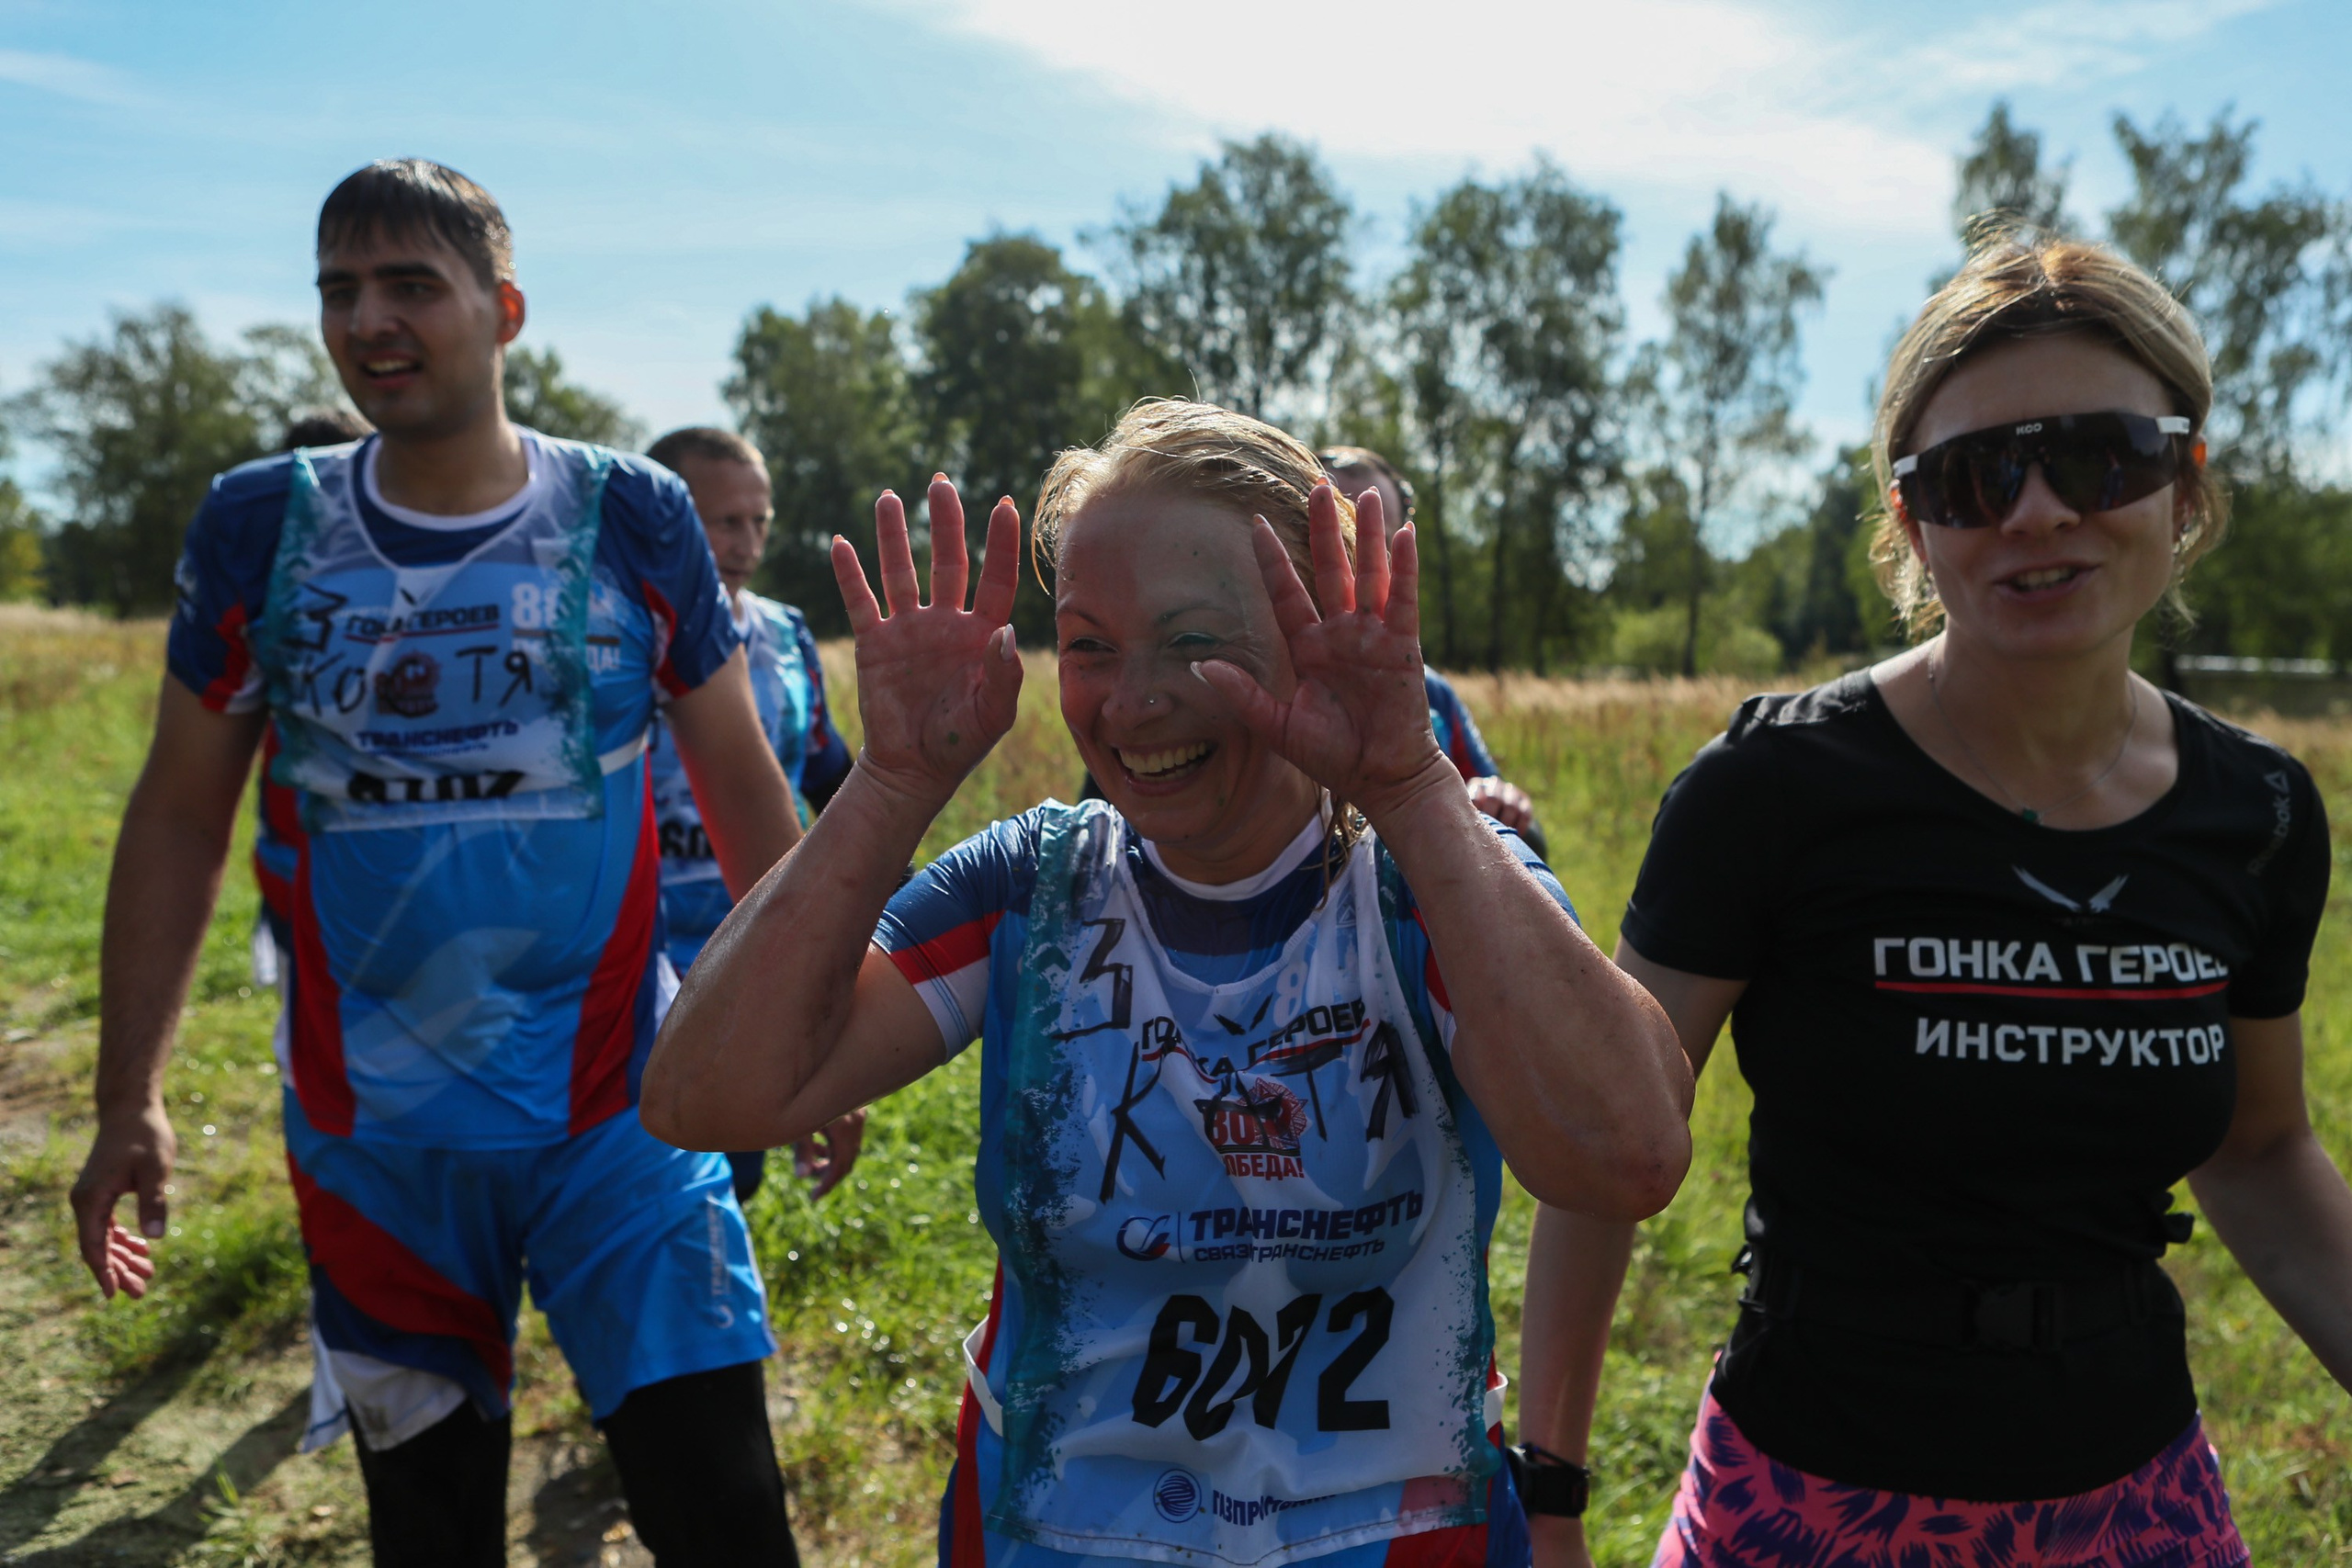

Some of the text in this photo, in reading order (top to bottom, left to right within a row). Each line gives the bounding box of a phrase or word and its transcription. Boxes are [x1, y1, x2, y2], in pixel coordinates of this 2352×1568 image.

[1873, 937, 2063, 982] ГОНКА
[1142, 1016, 1235, 1077] ГОКА
[1916, 1016, 2225, 1066] ИНСТРУКТОР
[1223, 1154, 1305, 1181] ОБЕДА!
[1189, 1191, 1423, 1243] ТРАНСНЕФТЬ
[1132, 1286, 1395, 1442] 6072
